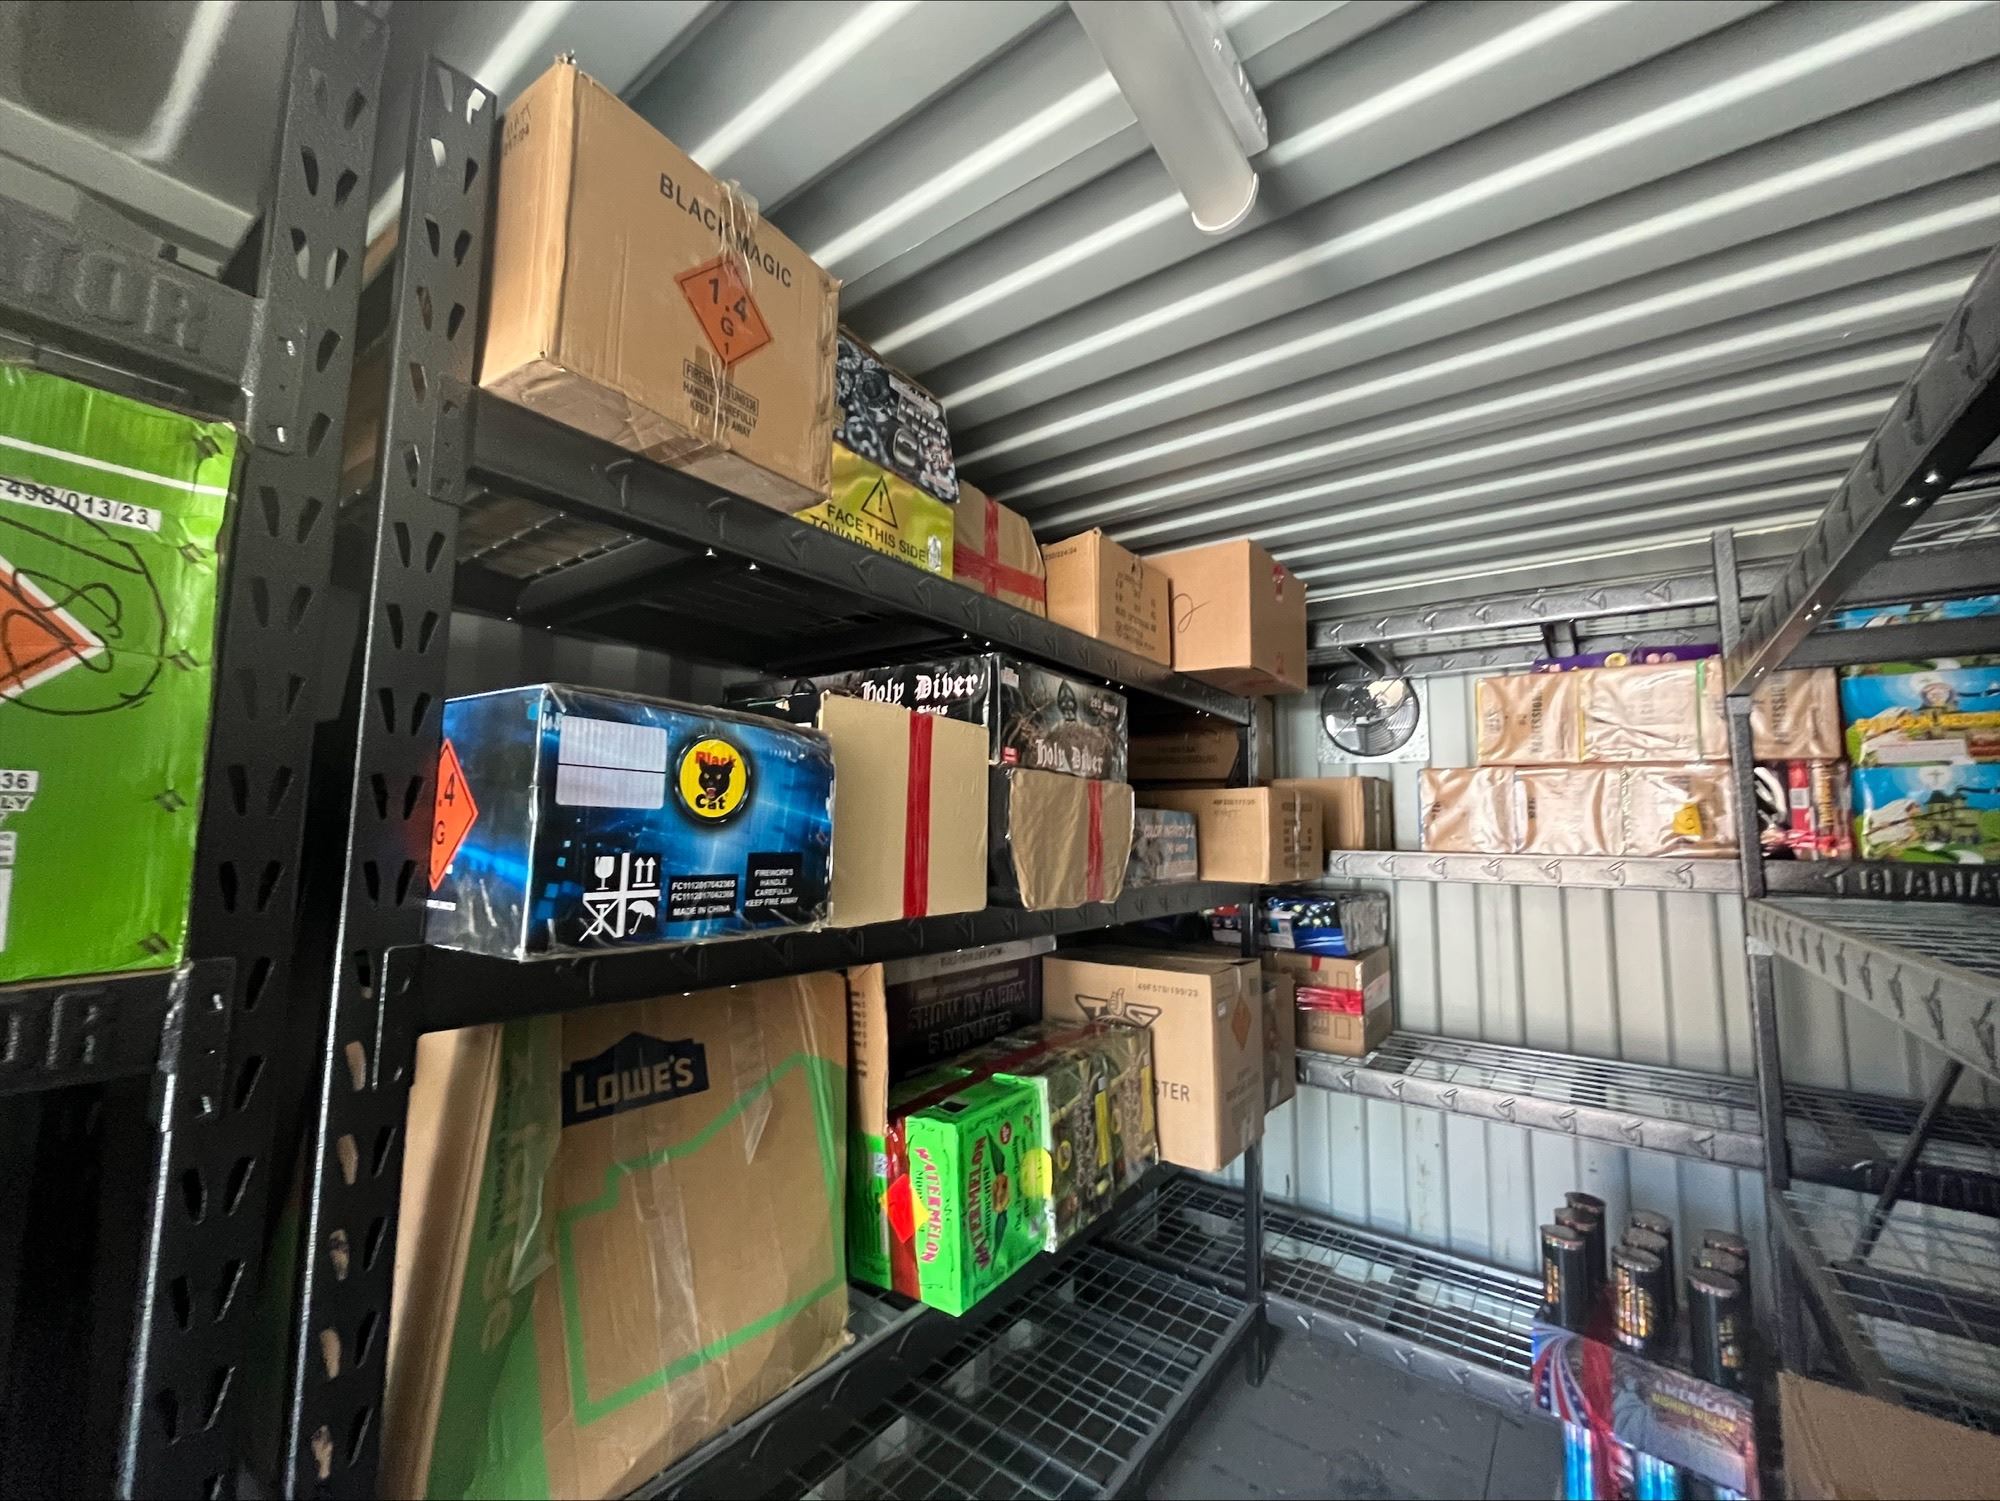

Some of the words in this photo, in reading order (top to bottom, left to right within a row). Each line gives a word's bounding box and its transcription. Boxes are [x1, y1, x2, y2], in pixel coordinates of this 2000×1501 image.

[660, 172, 731, 242] BLACK
[736, 230, 792, 288] MAGIC
[721, 317, 734, 337] G
[826, 504, 864, 534] FACE
[867, 523, 896, 549] THIS
[899, 538, 926, 564] SIDE
[695, 793, 726, 811] Cat
[754, 868, 794, 878] FIREWORKS
[760, 878, 788, 887] HANDLE
[754, 887, 793, 897] CAREFULLY
[673, 906, 696, 916] MADE
[698, 906, 706, 914] IN
[707, 904, 730, 914] CHINA
[574, 1054, 695, 1113] LOWE'S
[914, 1148, 943, 1263] WATERMELON
[968, 1135, 991, 1270] WATERMELON
